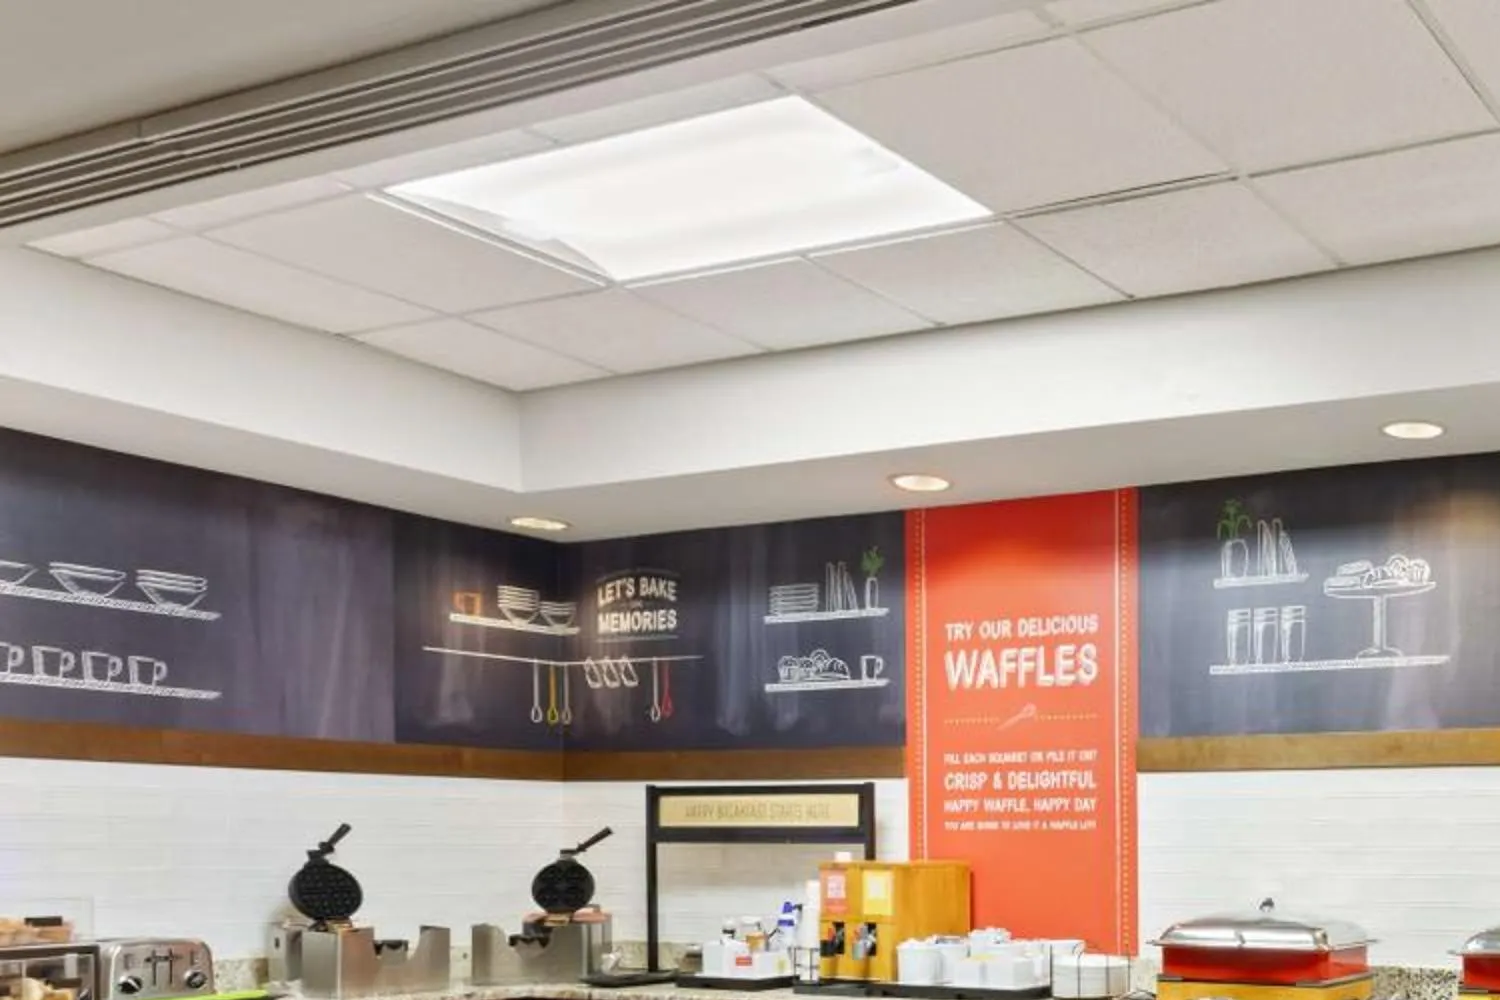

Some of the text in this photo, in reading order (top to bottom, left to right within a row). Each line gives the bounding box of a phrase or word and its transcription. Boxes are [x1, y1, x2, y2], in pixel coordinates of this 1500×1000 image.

[597, 577, 678, 608] LET'S BAKE
[598, 608, 677, 634] MEMORIES
[945, 613, 1099, 641] TRY OUR DELICIOUS
[944, 643, 1098, 691] WAFFLES
[944, 768, 1097, 791] CRISP & DELIGHTFUL
[944, 798, 979, 813] HAPPY
[1033, 797, 1071, 811] HAPPY
[1074, 797, 1097, 811] DAY
